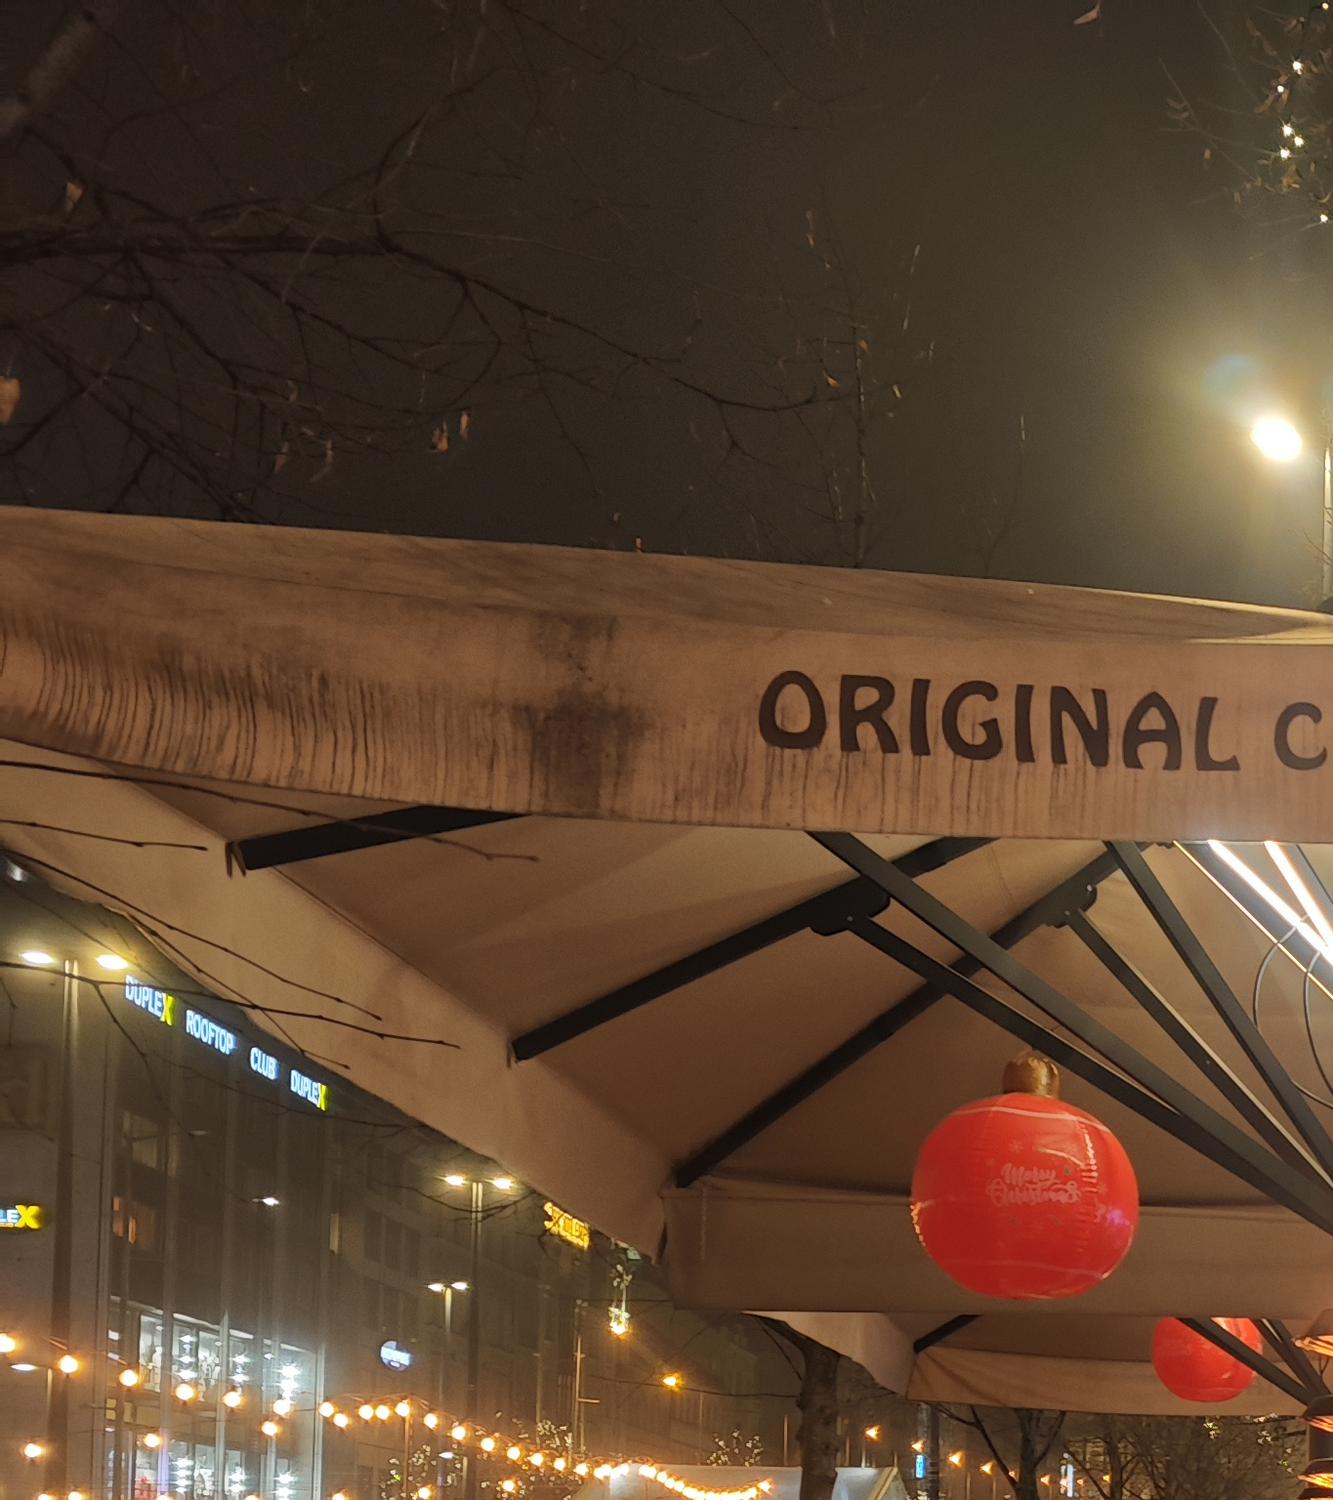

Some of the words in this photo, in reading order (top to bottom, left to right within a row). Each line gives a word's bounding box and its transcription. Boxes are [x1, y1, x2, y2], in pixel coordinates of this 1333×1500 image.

[758, 670, 1240, 772] ORIGINAL
[125, 975, 176, 1026] DUPLEX
[185, 1009, 237, 1055] ROOFTOP
[250, 1047, 278, 1080] CLUB
[290, 1069, 329, 1111] DUPLEX
